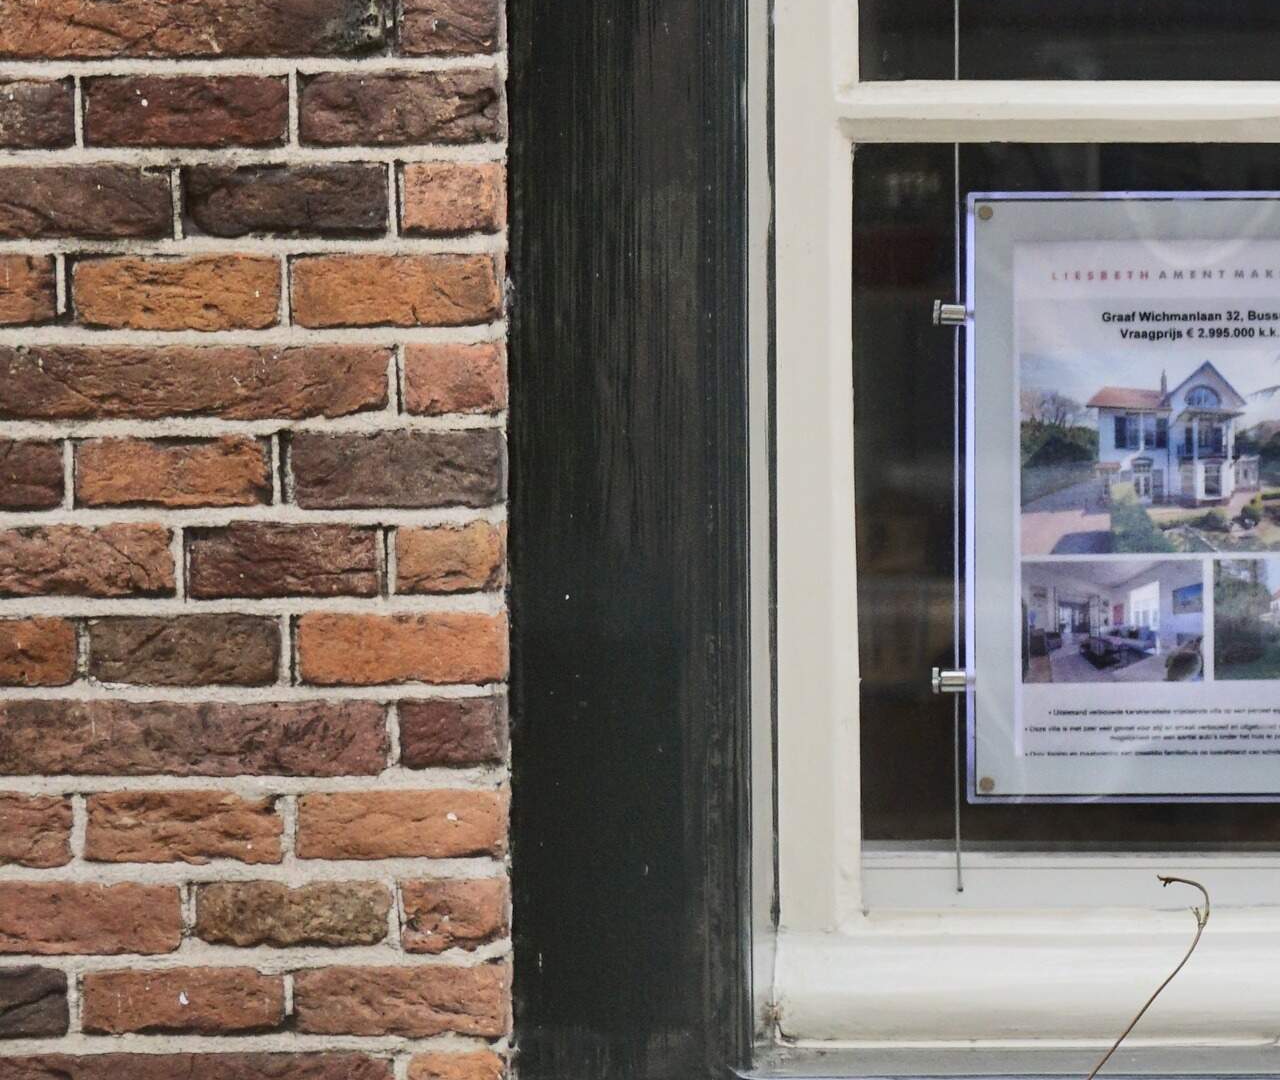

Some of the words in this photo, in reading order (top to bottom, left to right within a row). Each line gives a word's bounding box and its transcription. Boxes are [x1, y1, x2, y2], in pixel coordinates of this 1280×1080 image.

[1051, 271, 1150, 281] LIESBETH
[1158, 270, 1225, 280] AMENT
[1101, 311, 1137, 322] Graaf
[1138, 310, 1222, 322] Wichmanlaan
[1226, 310, 1244, 323] 32,
[1119, 328, 1184, 341] Vraagprijs
[1185, 327, 1194, 338] €
[1197, 326, 1256, 338] 2.995.000
[1258, 326, 1280, 338] k.k.
